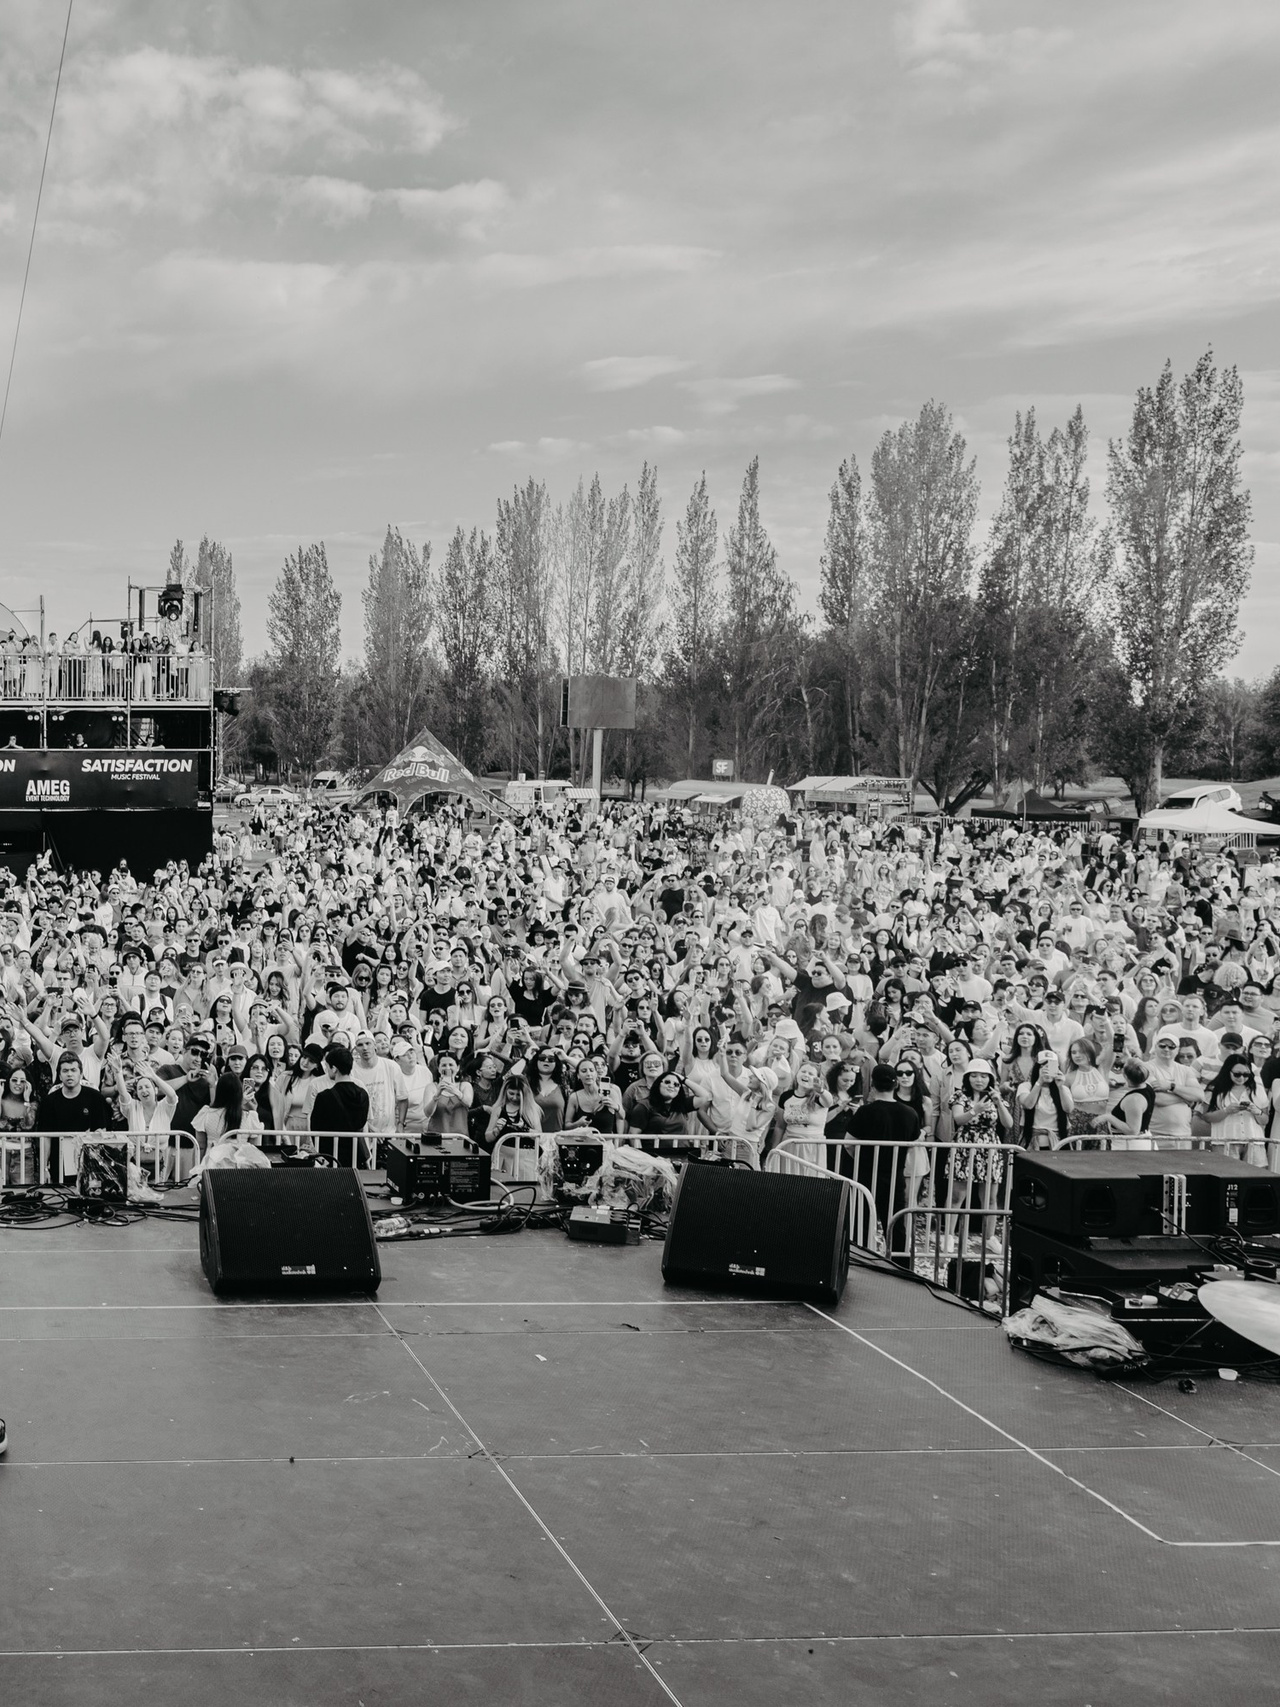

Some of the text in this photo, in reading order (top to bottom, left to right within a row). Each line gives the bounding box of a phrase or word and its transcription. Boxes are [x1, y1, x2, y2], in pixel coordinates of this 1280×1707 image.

[81, 759, 193, 772] SATISFACTION
[383, 762, 417, 782] Red
[415, 762, 450, 783] Bull
[715, 761, 728, 774] SF
[25, 779, 70, 795] AMEG
